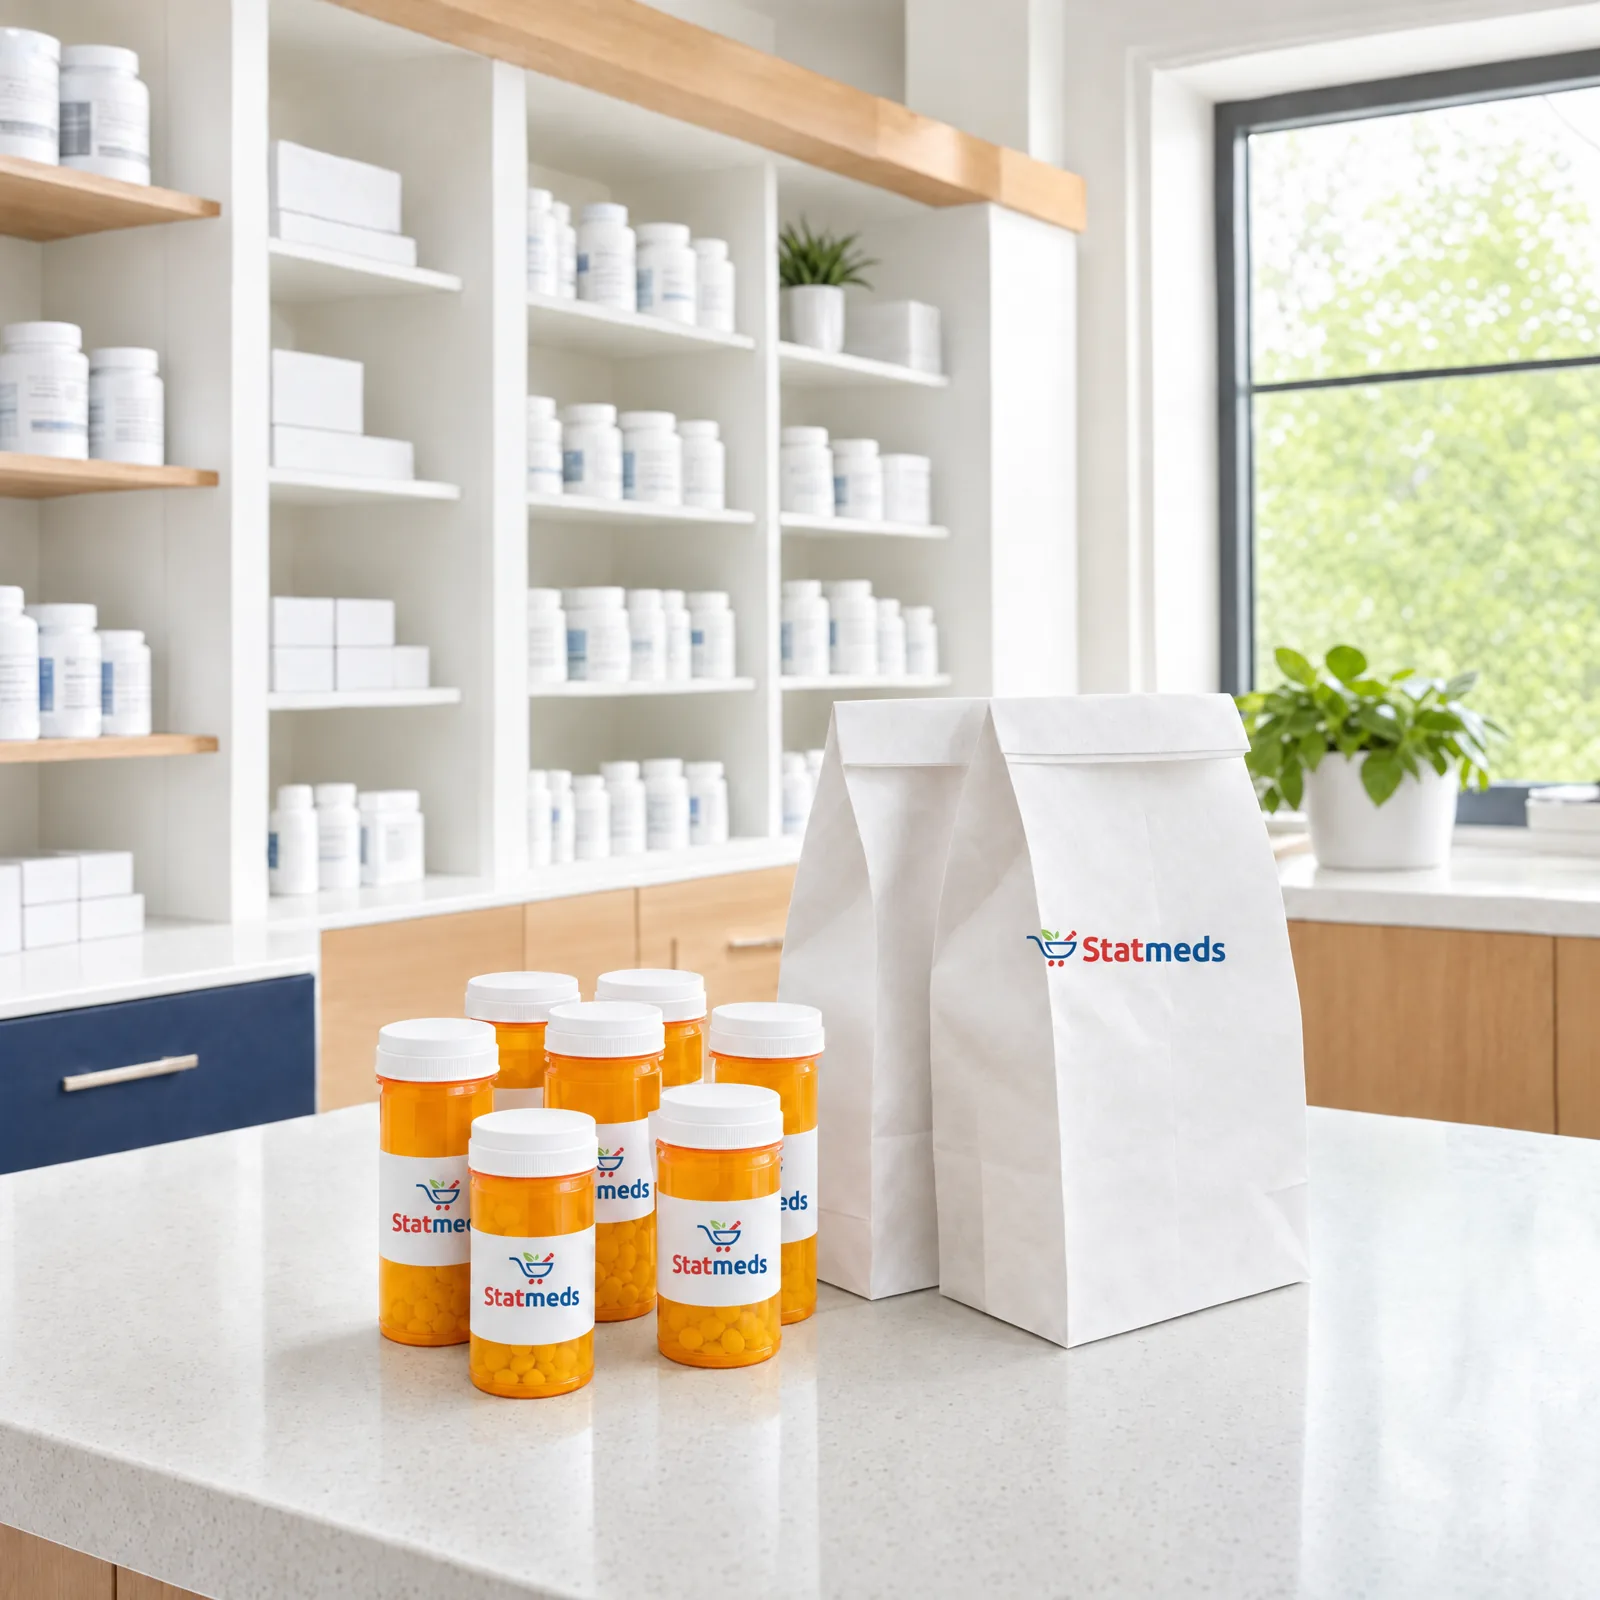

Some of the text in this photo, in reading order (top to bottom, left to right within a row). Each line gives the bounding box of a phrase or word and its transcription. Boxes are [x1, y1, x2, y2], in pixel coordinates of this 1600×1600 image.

[1082, 935, 1226, 963] Statmeds
[595, 1178, 650, 1200] meds
[672, 1253, 768, 1275] Statmeds
[484, 1286, 580, 1308] Statmeds
